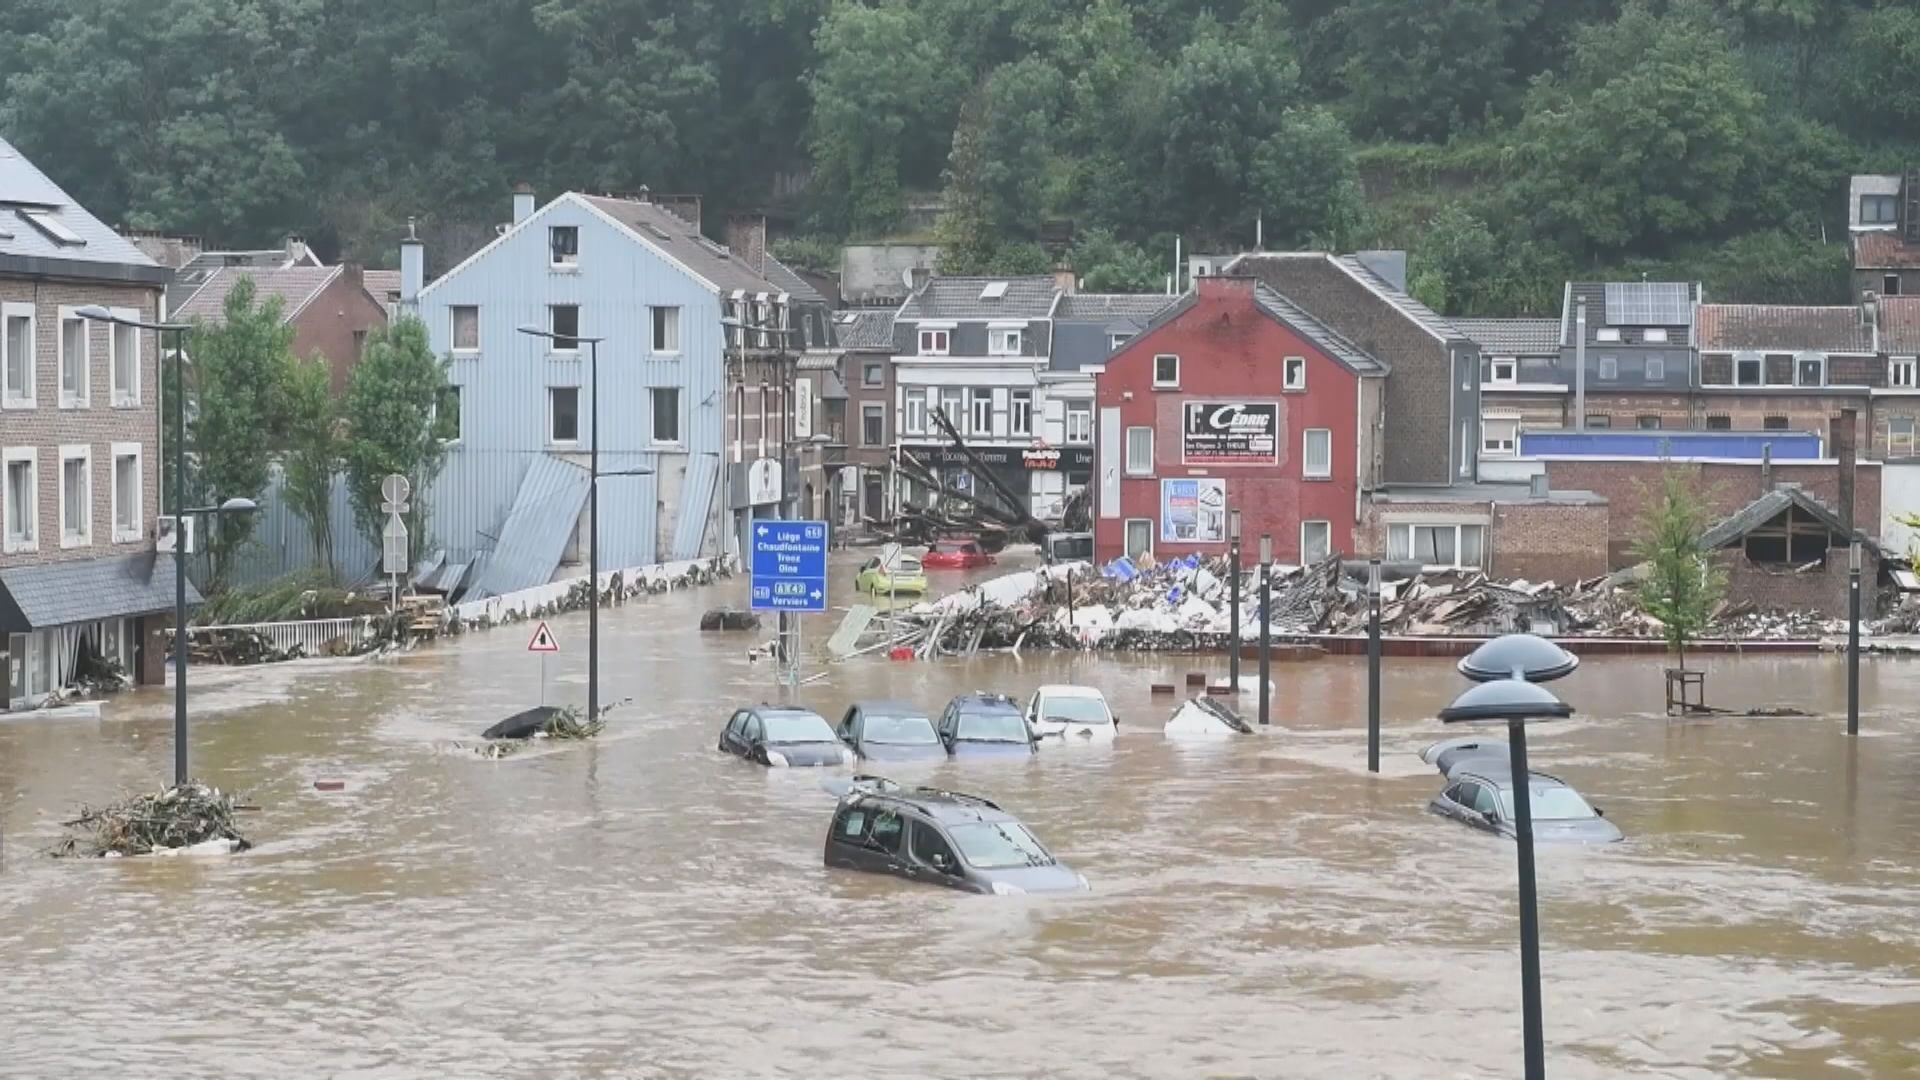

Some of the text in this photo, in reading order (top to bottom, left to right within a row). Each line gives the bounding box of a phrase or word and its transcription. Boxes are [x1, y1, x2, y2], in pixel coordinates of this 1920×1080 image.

[777, 532, 800, 543] Liège
[757, 542, 820, 552] Chaudfontaine
[772, 596, 808, 605] Verviers
